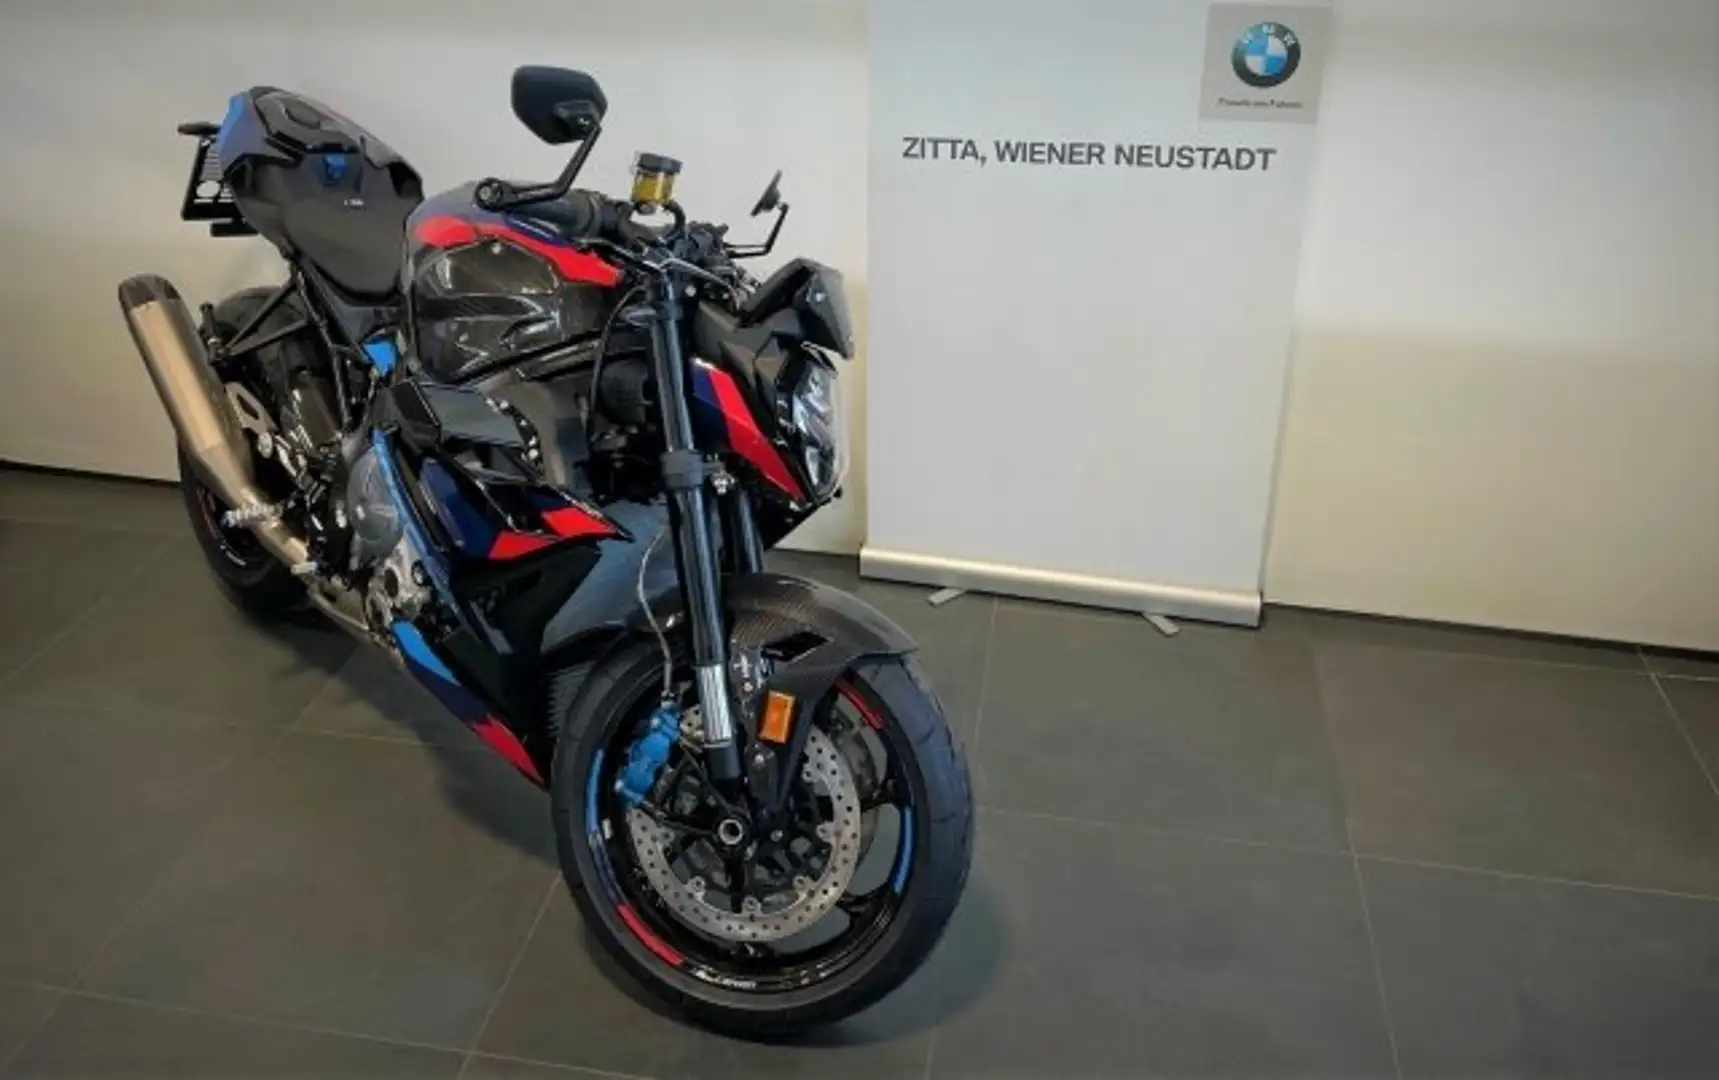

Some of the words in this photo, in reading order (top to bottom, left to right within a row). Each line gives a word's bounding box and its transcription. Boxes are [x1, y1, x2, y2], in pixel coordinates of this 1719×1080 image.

[902, 136, 988, 168] ZITTA,
[993, 140, 1105, 166] WIENER
[1114, 143, 1278, 171] NEUSTADT
